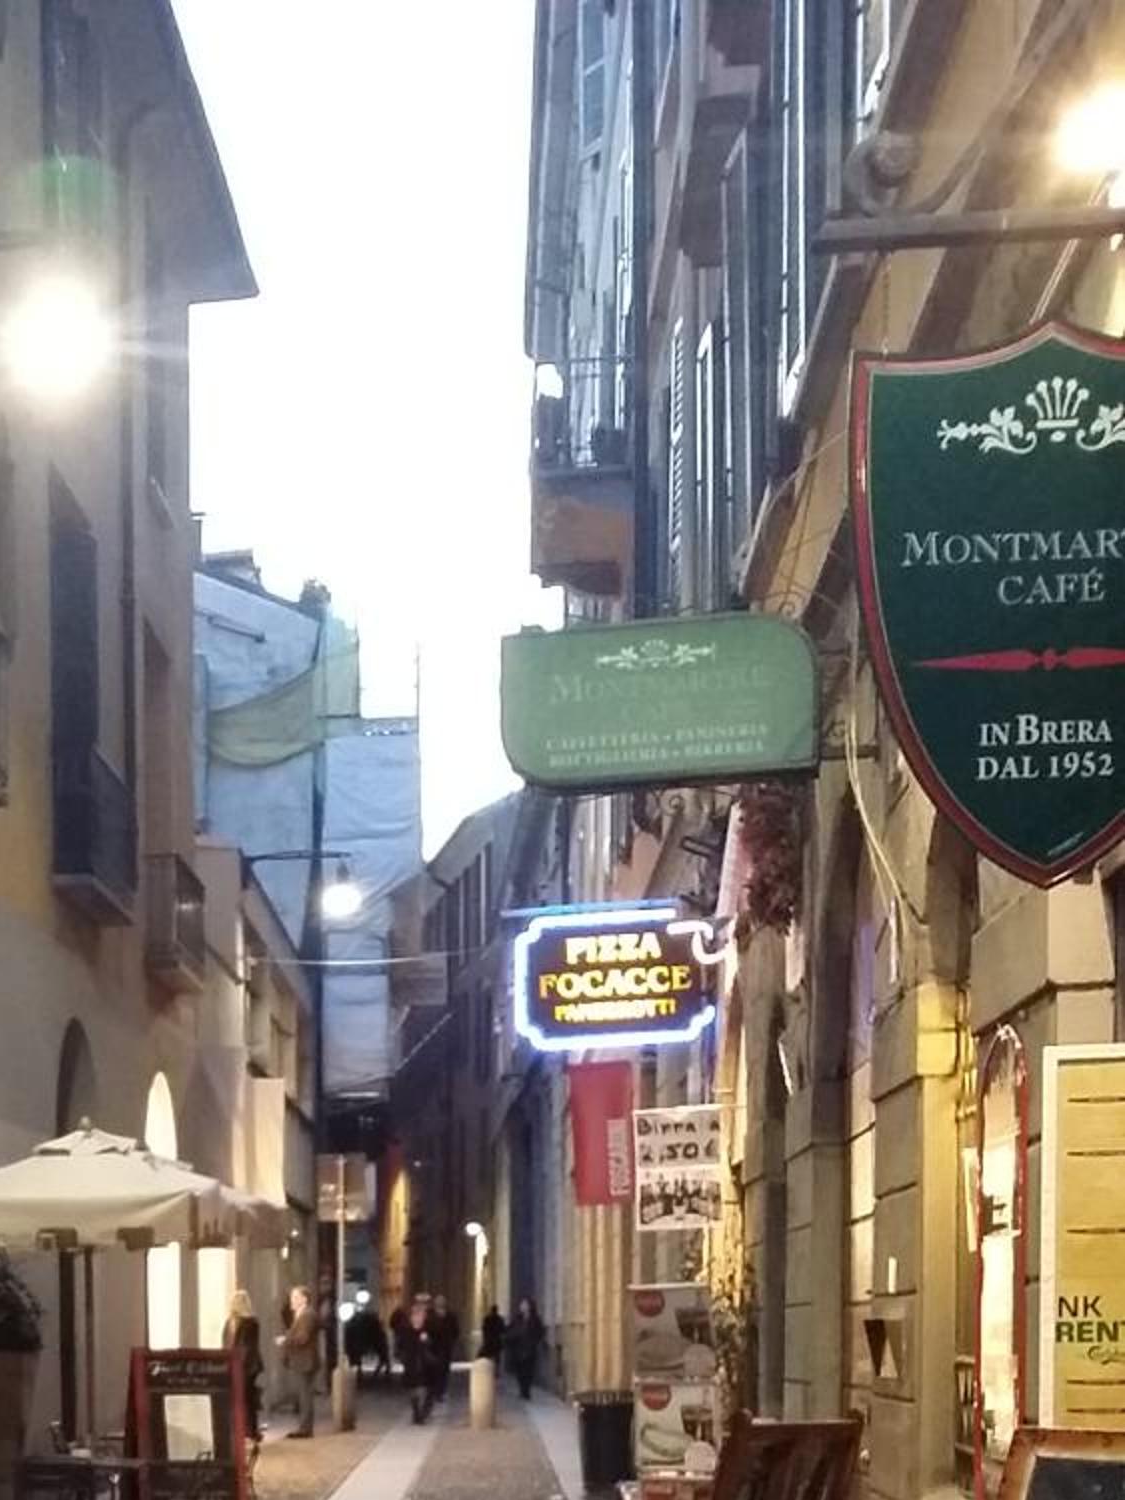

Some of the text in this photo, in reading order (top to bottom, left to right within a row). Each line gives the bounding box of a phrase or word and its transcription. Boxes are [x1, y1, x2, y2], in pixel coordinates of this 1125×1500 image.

[900, 528, 1125, 567] MONTMAR
[998, 566, 1104, 605] CAFÉ
[979, 713, 1113, 747] IN BRERA
[976, 751, 1115, 781] DAL 1952
[565, 931, 662, 965] PIZZA
[538, 964, 692, 999] FOCACCE
